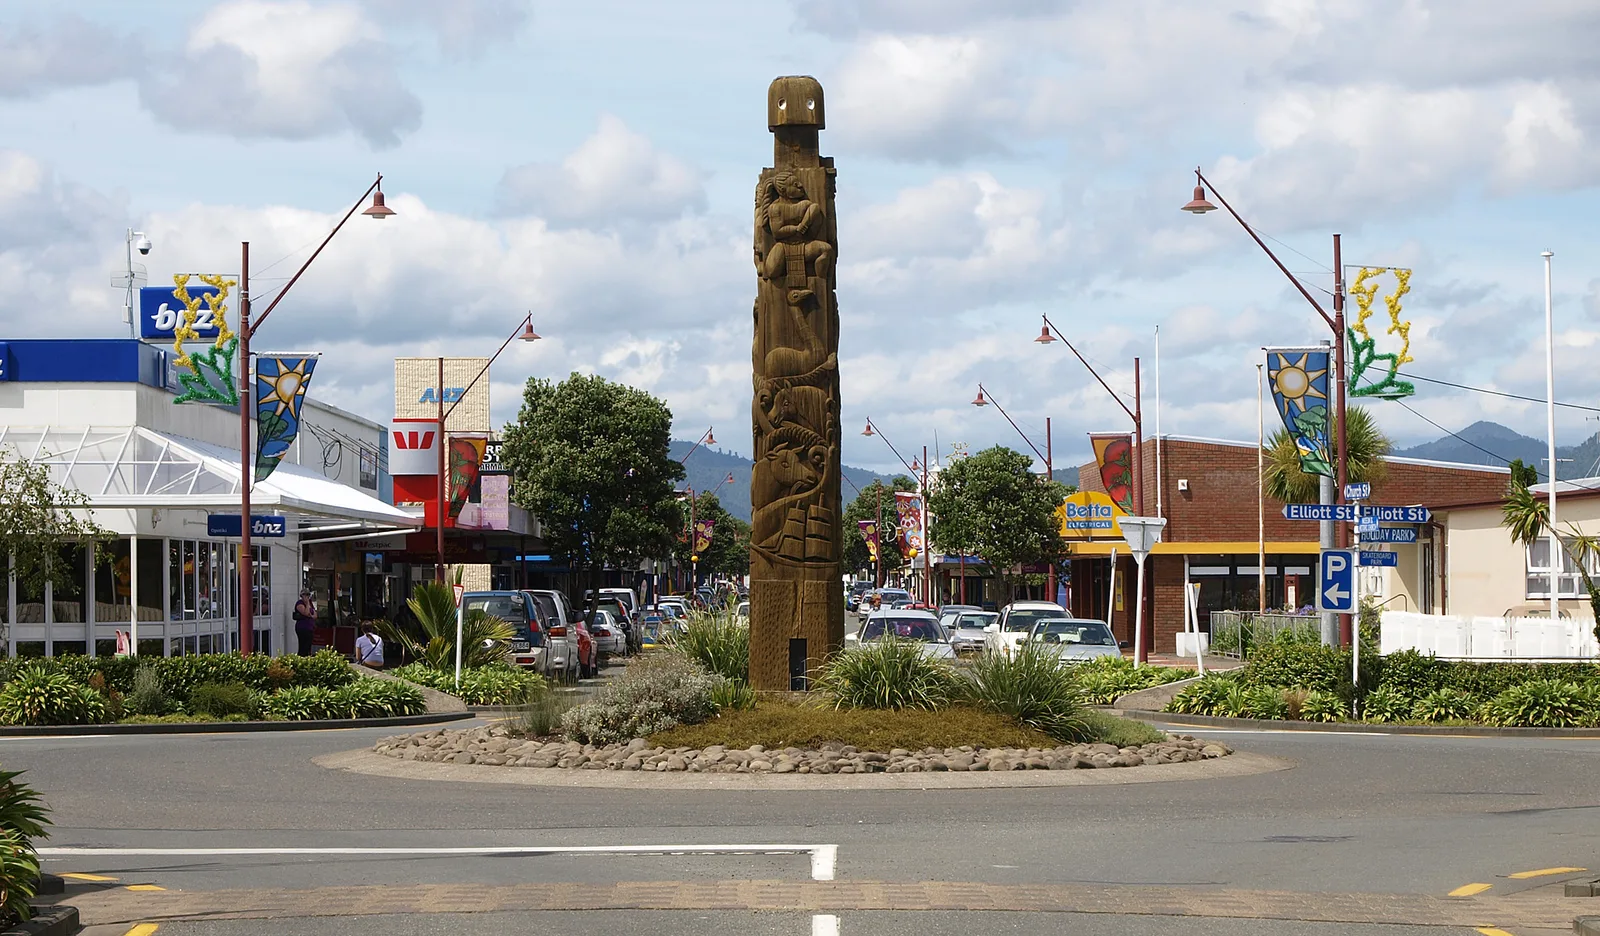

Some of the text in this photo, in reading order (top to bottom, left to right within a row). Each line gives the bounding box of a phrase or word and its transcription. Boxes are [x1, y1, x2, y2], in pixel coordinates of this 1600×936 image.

[418, 387, 465, 403] ANZ
[1346, 485, 1362, 498] Church
[1066, 502, 1113, 518] Betta
[1290, 505, 1351, 519] Elliott St
[1363, 507, 1424, 521] Elliott St
[252, 520, 282, 534] bnz
[1068, 521, 1110, 529] ELECTRICAL
[1361, 529, 1410, 541] HOLIDAY PARK
[355, 541, 392, 549] Westpac
[1362, 552, 1392, 560] SKATEBOARD
[1327, 555, 1347, 580] P
